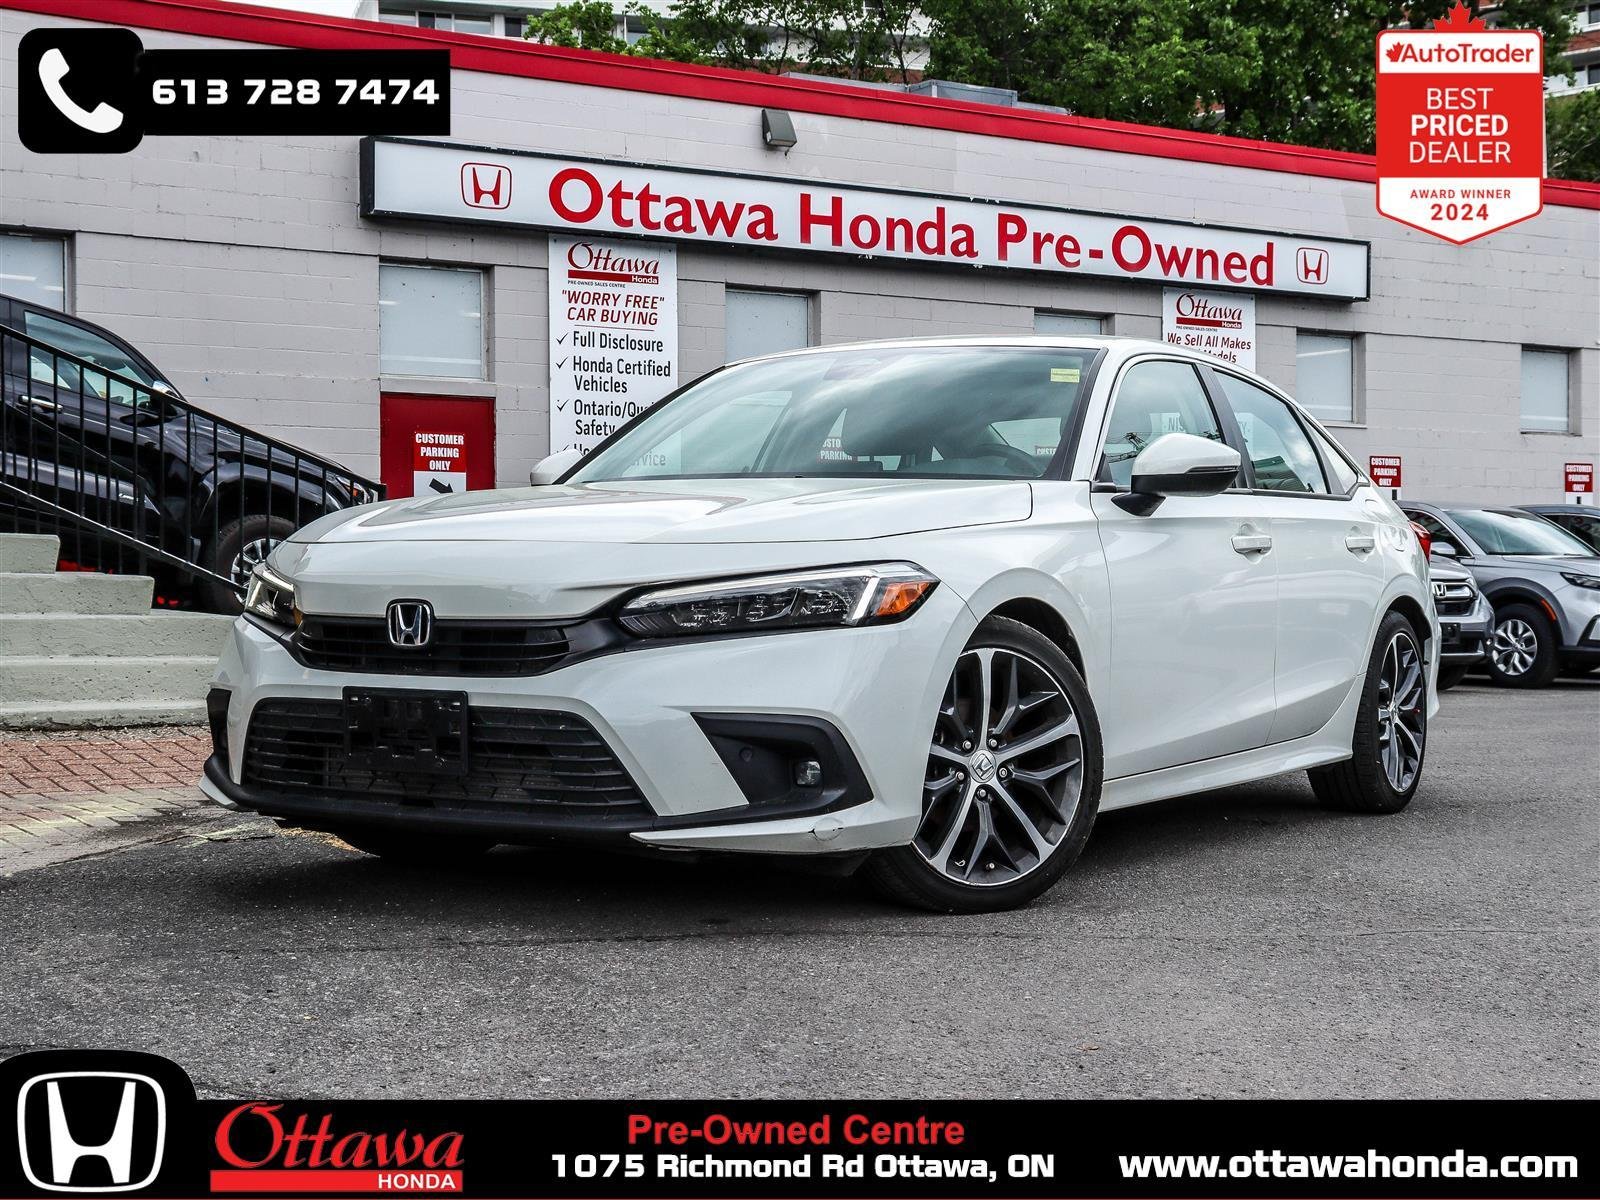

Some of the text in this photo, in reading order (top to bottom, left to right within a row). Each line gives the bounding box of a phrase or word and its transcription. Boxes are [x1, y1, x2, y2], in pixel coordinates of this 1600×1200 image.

[548, 167, 1274, 286] Ottawa Honda Pre-Owned
[567, 241, 660, 275] Ottawa
[631, 275, 658, 284] Honda
[562, 289, 664, 310] "WORRY FREE"
[1176, 292, 1242, 321] Ottawa
[567, 307, 658, 326] CAR BUYING
[1221, 321, 1242, 329] Honda
[573, 330, 664, 352] Full Disclosure
[1167, 332, 1251, 350] We Sell All Makes
[573, 355, 671, 377] Honda Certified
[574, 374, 628, 393] Vehicles
[415, 433, 464, 445] CUSTOMER
[420, 446, 459, 458] PARKING
[429, 460, 451, 471] ONLY
